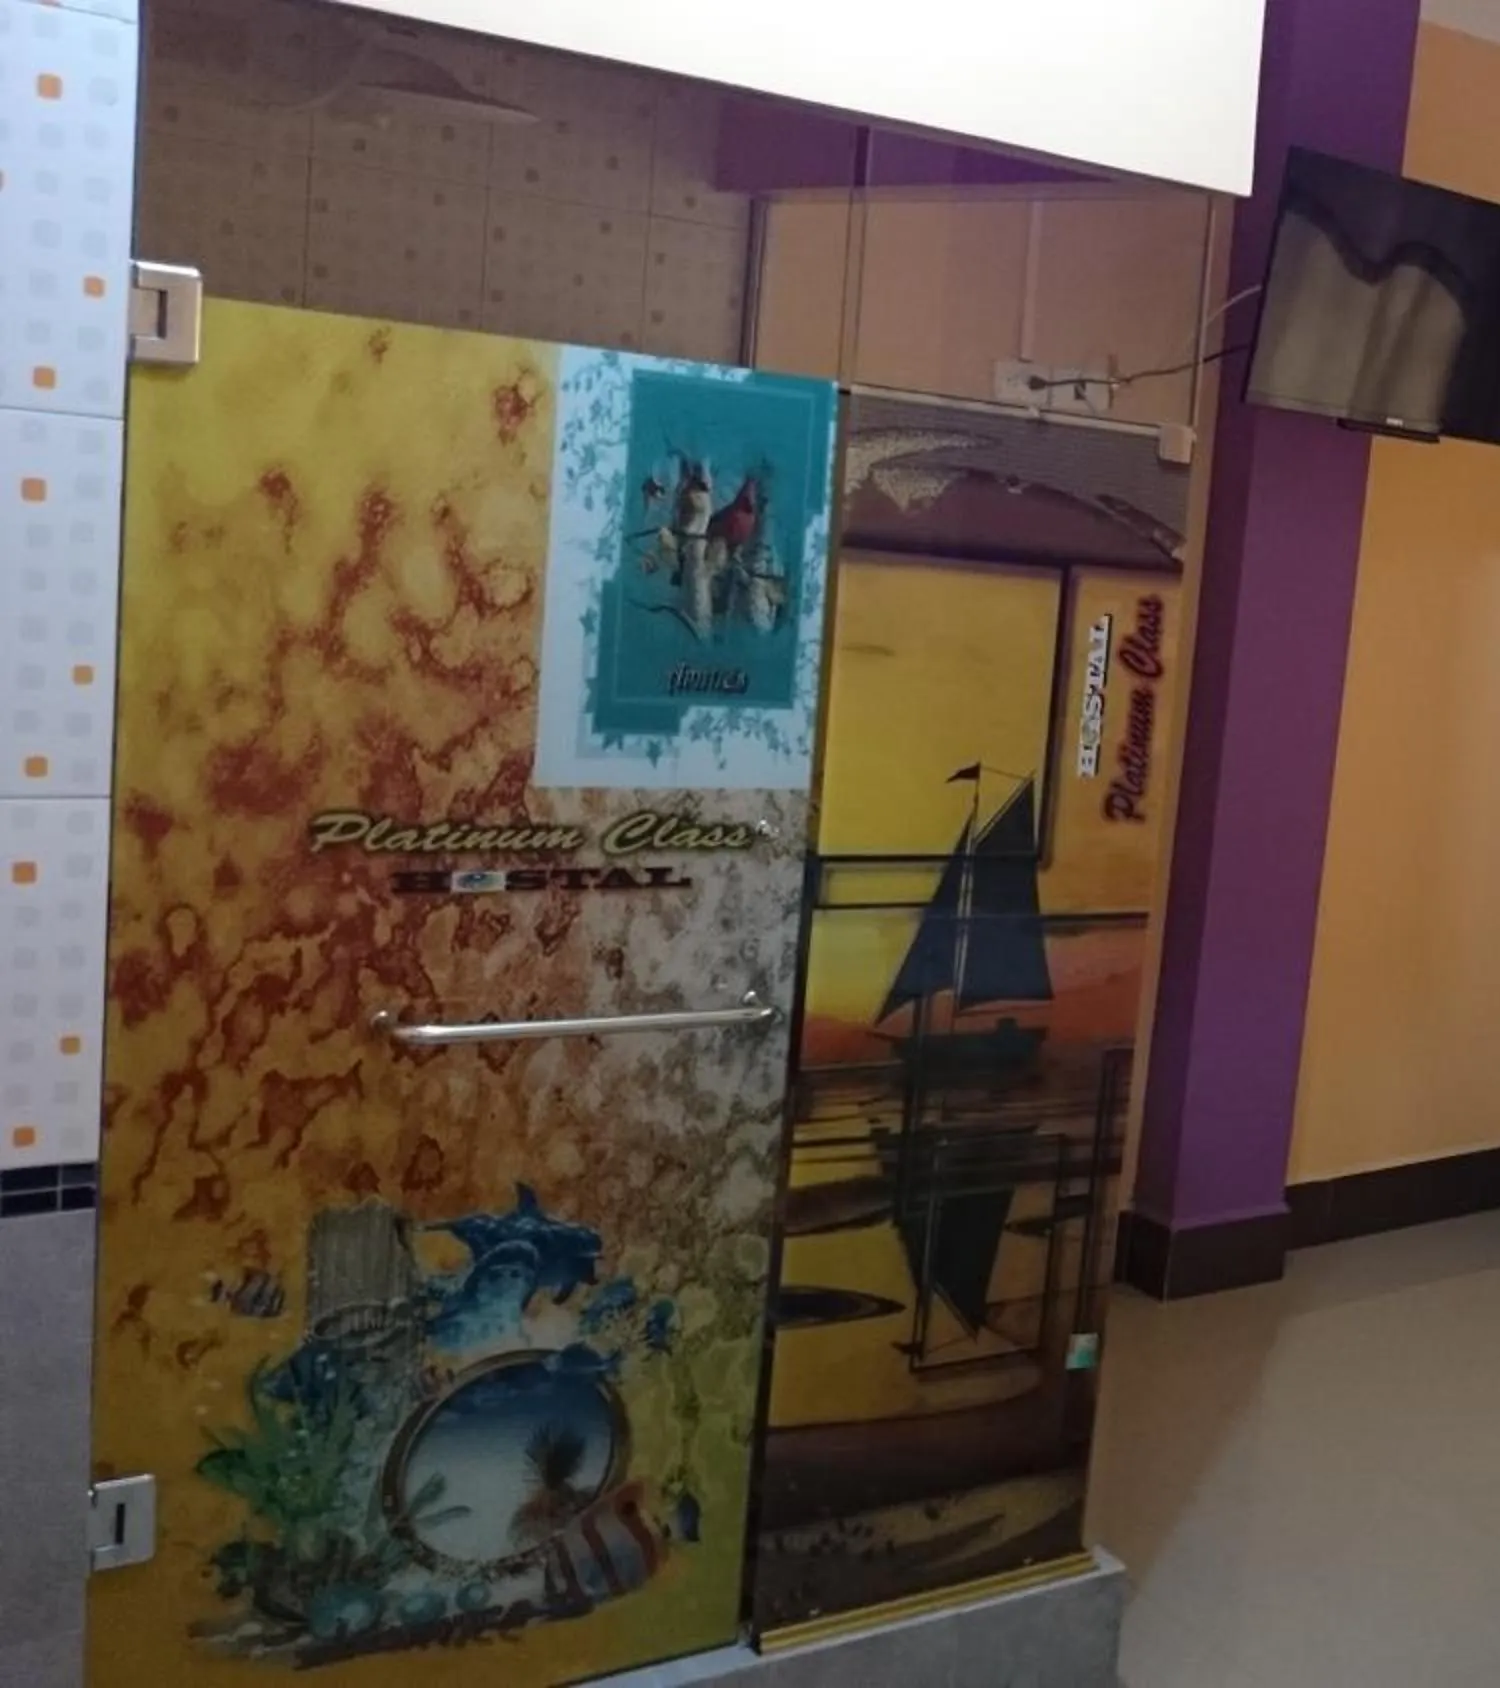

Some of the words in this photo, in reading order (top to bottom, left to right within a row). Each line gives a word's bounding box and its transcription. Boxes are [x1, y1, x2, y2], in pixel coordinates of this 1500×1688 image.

[1118, 593, 1164, 679] Class
[1103, 688, 1156, 823] Platinum
[310, 809, 584, 854] Platinum
[602, 811, 754, 855] Class
